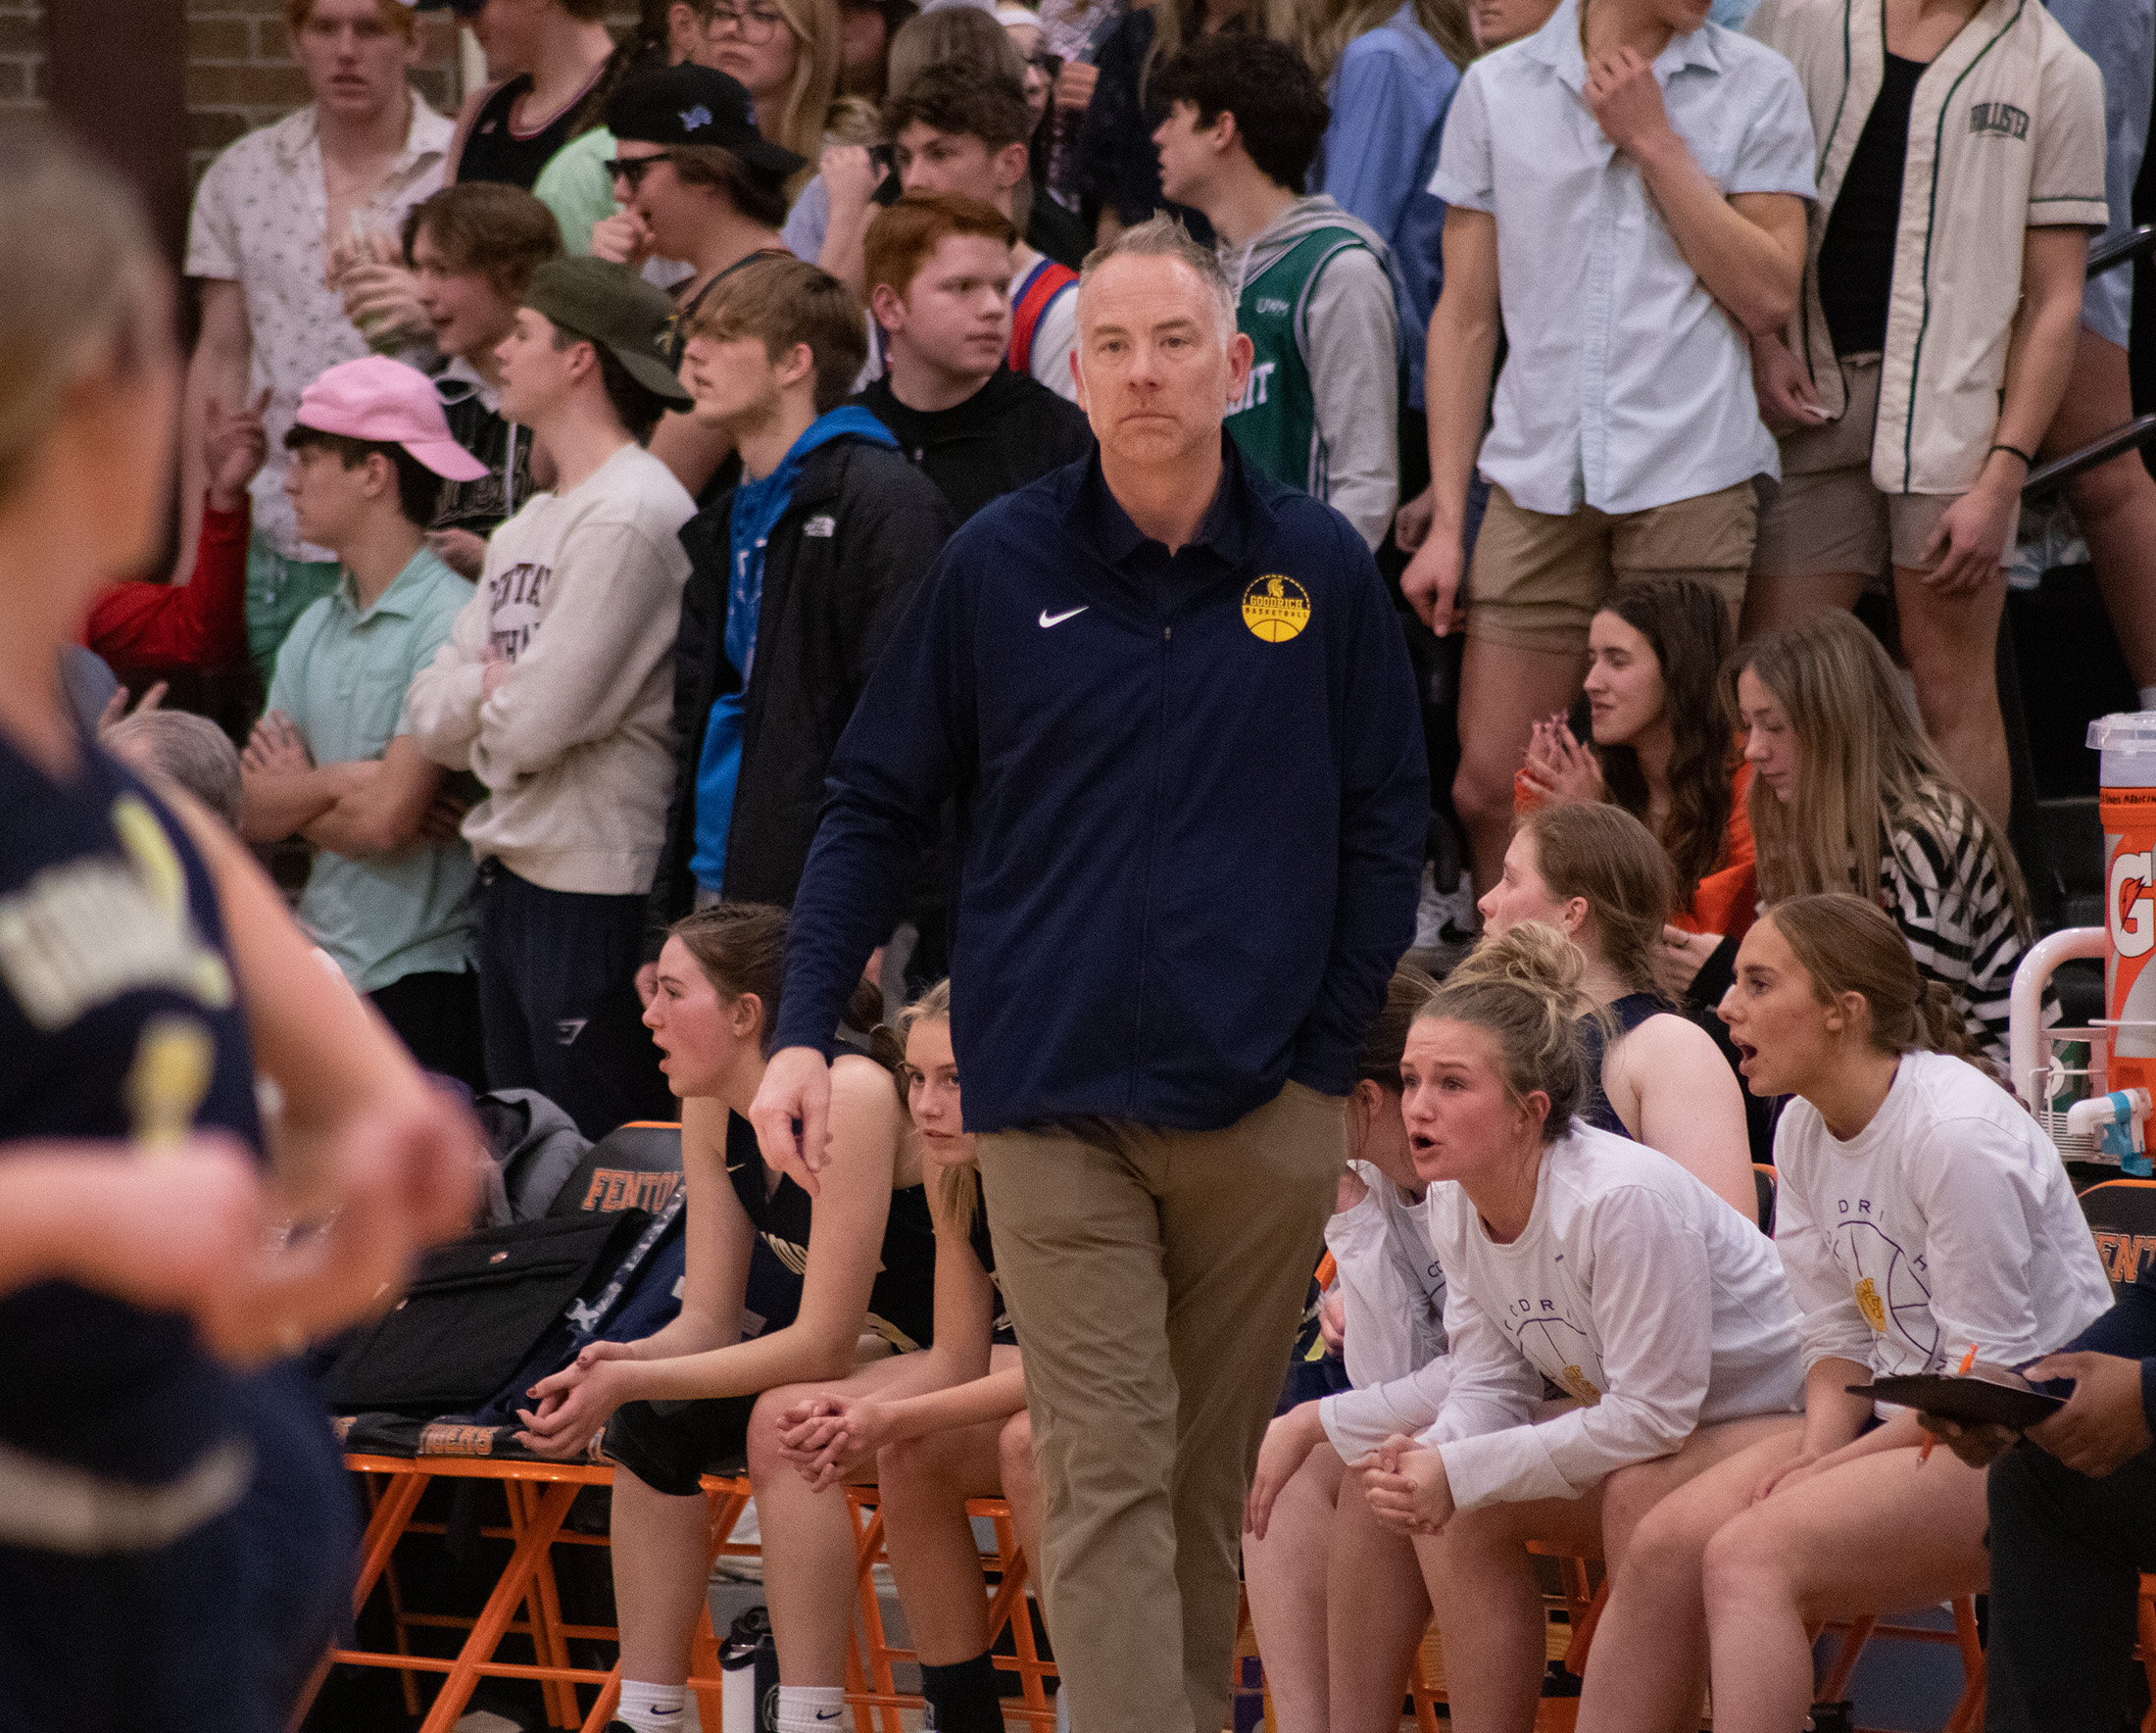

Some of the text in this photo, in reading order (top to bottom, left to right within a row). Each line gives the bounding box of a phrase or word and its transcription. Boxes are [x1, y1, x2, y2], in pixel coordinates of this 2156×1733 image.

[1250, 595, 1303, 610] GOODRICH
[1245, 607, 1308, 619] BASKETBALL
[2109, 851, 2155, 959] G
